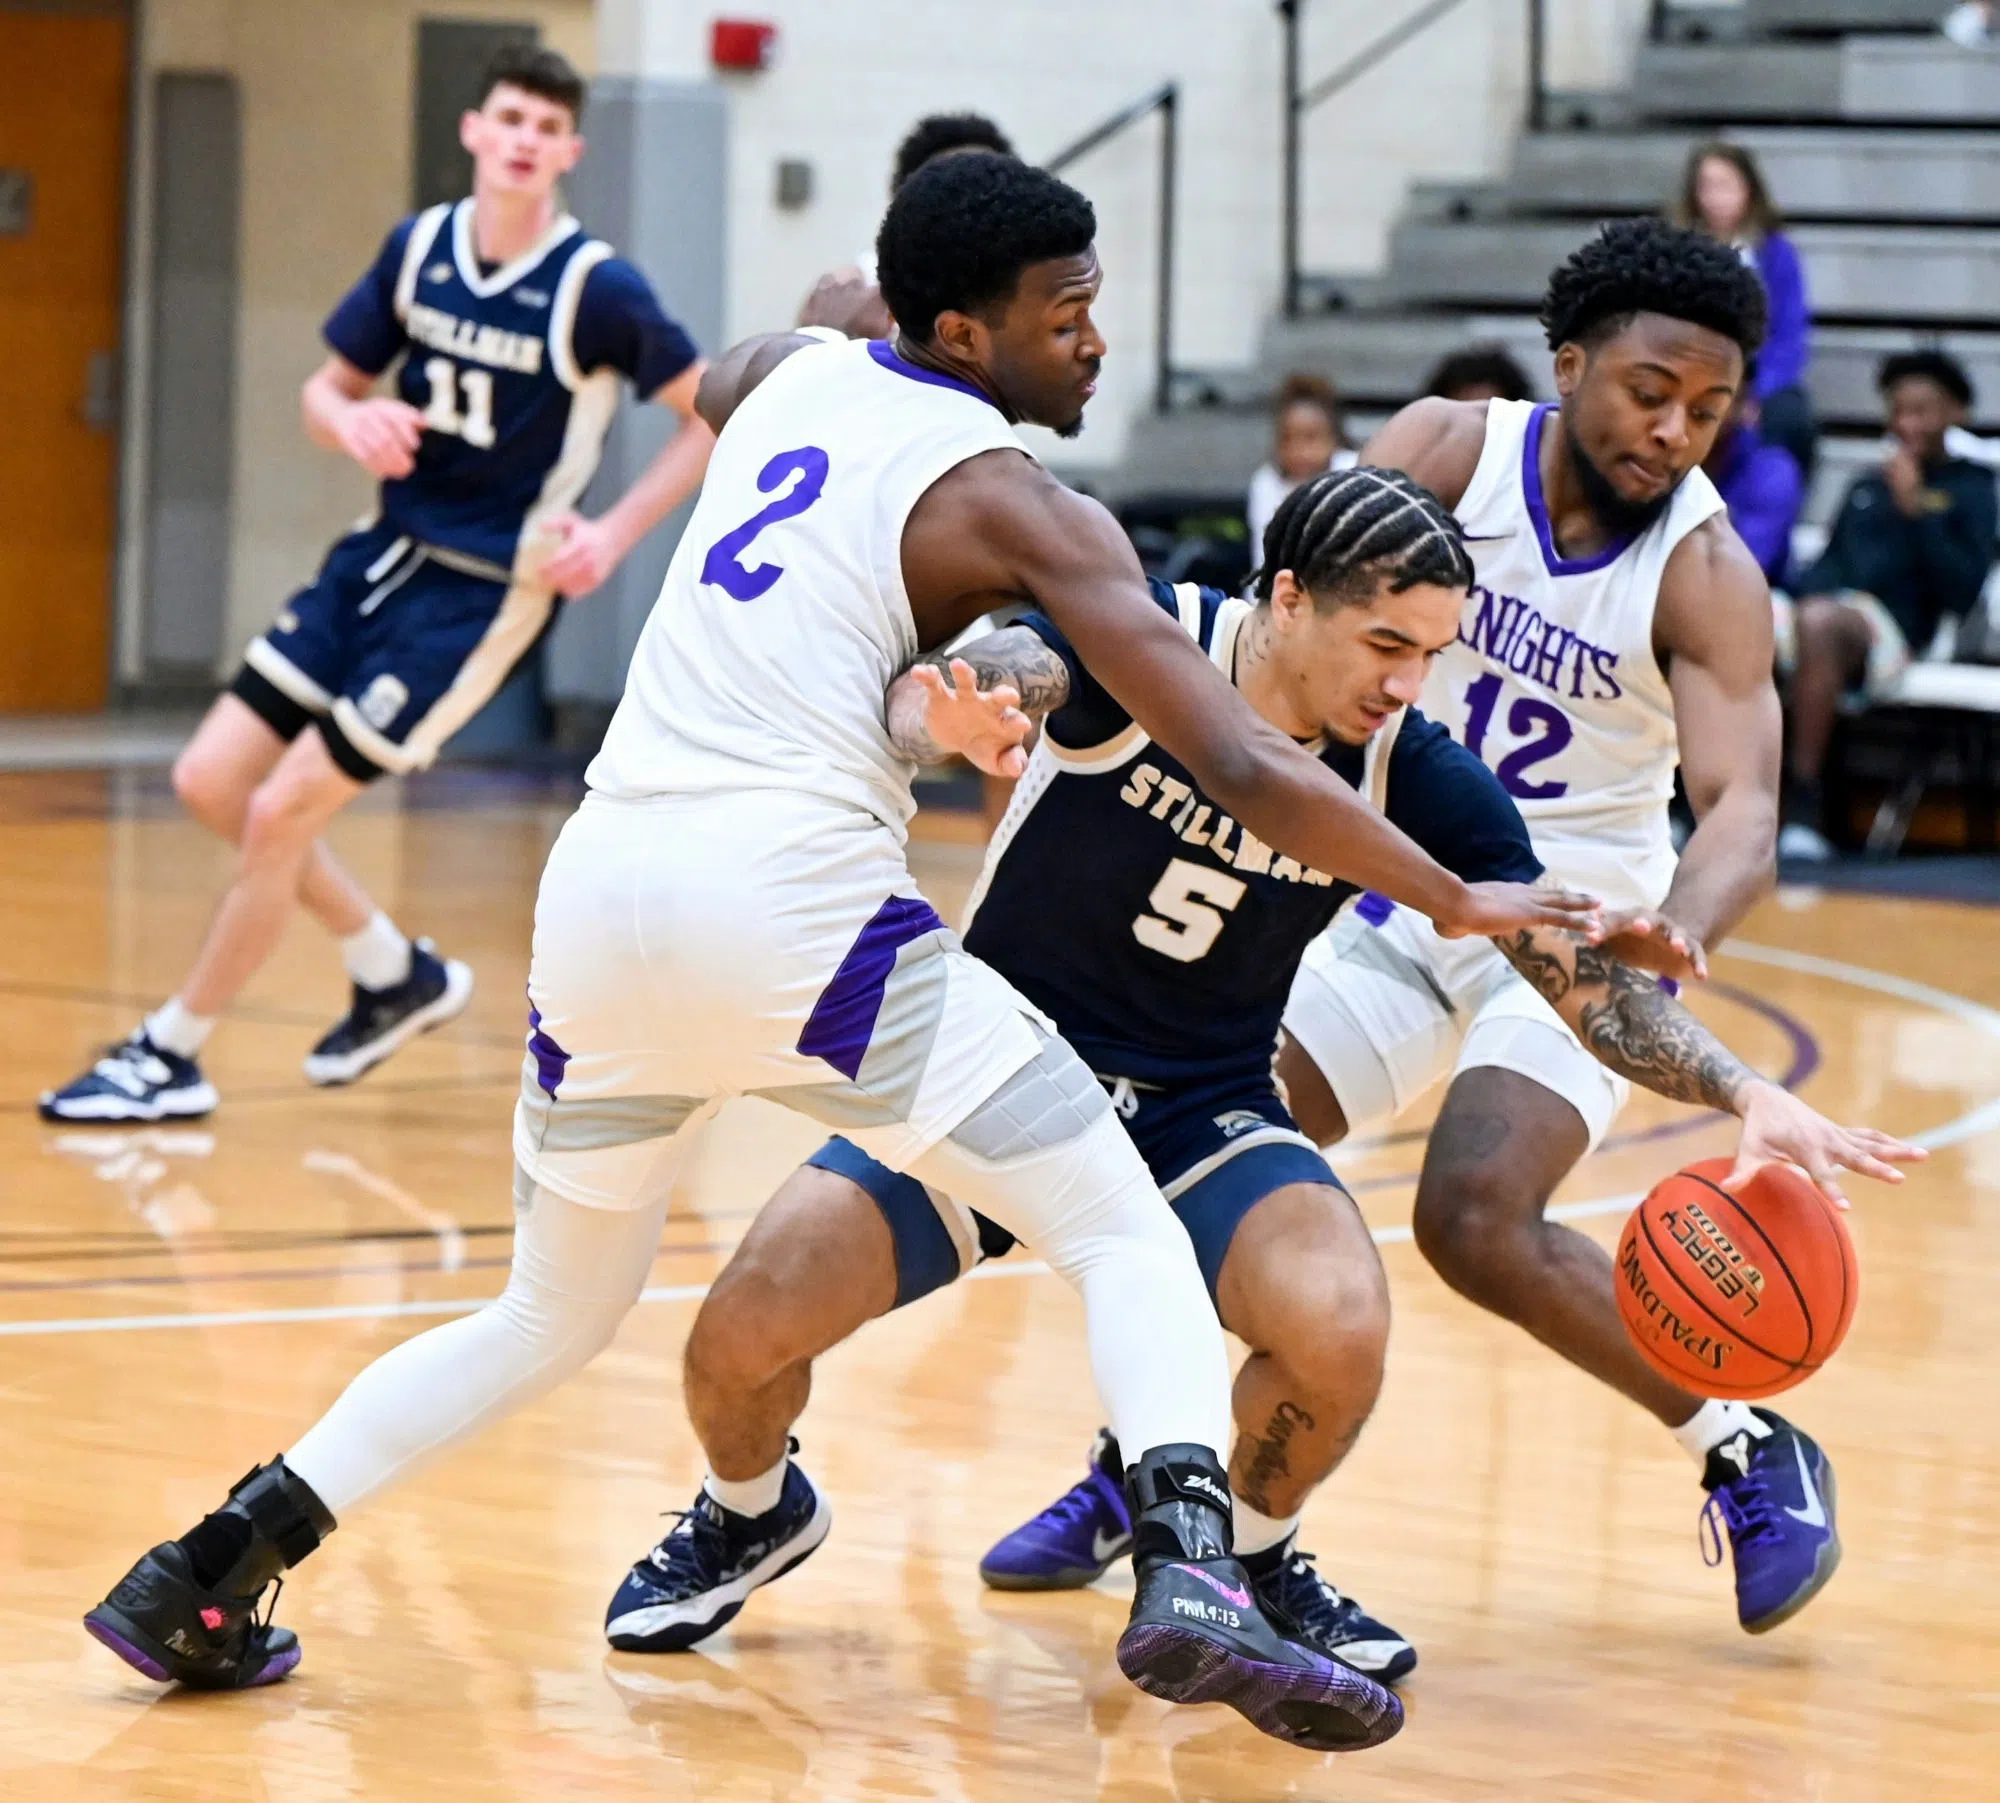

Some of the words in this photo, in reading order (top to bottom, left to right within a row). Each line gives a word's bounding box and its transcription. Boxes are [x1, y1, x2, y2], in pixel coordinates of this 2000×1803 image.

[423, 357, 497, 449] 11
[700, 445, 829, 602] 2
[1464, 671, 1573, 799] 12
[1131, 857, 1248, 963] 5
[1620, 1236, 1732, 1369] SPALDING
[1660, 1210, 1759, 1318] LEGACY
